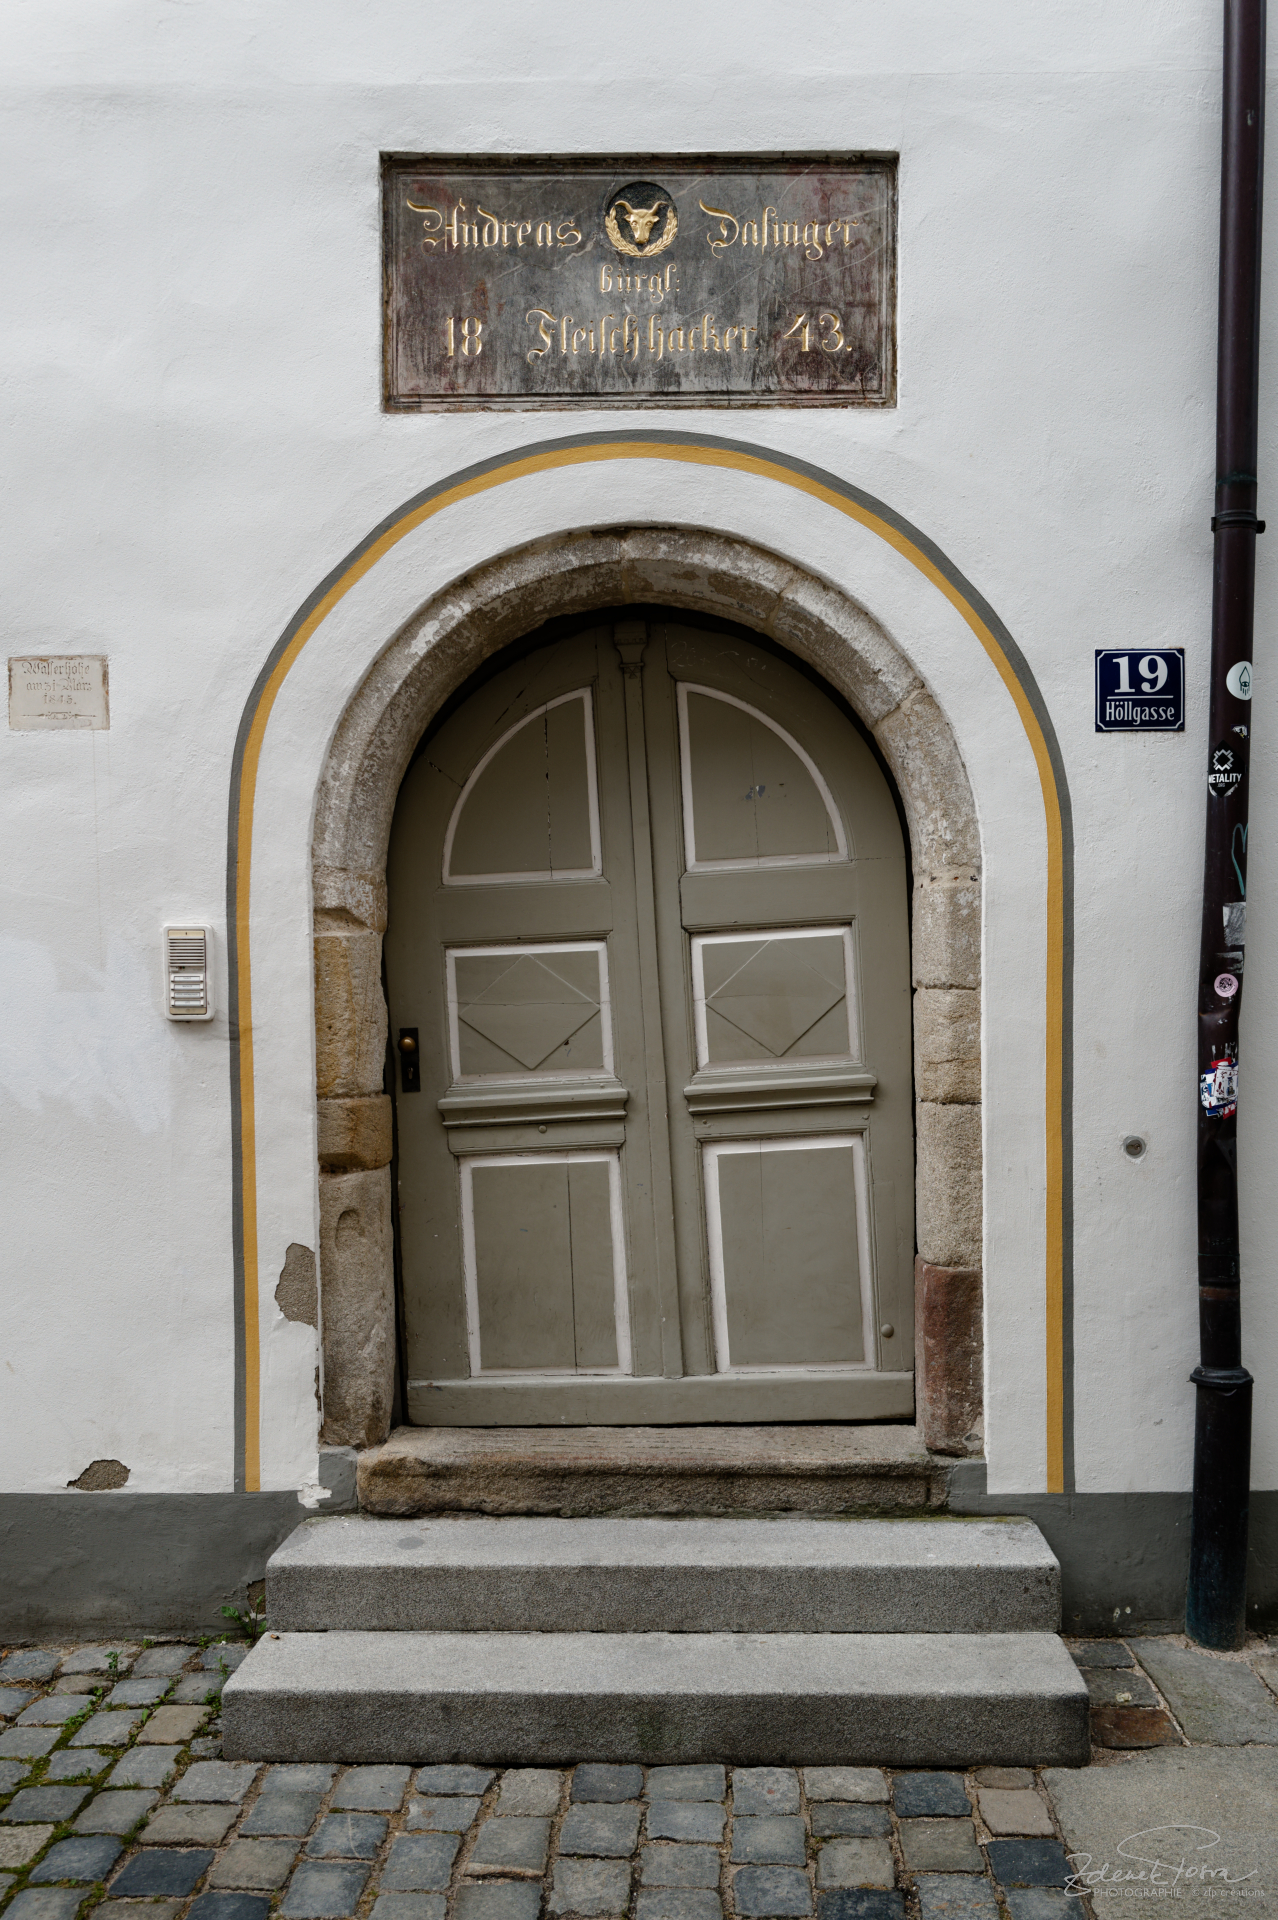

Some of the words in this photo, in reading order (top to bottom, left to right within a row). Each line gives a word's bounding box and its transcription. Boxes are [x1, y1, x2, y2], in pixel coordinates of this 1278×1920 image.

[406, 197, 582, 256] Andreas
[444, 316, 483, 357] 18
[1112, 655, 1168, 693] 19
[1105, 701, 1175, 725] Höllgasse
